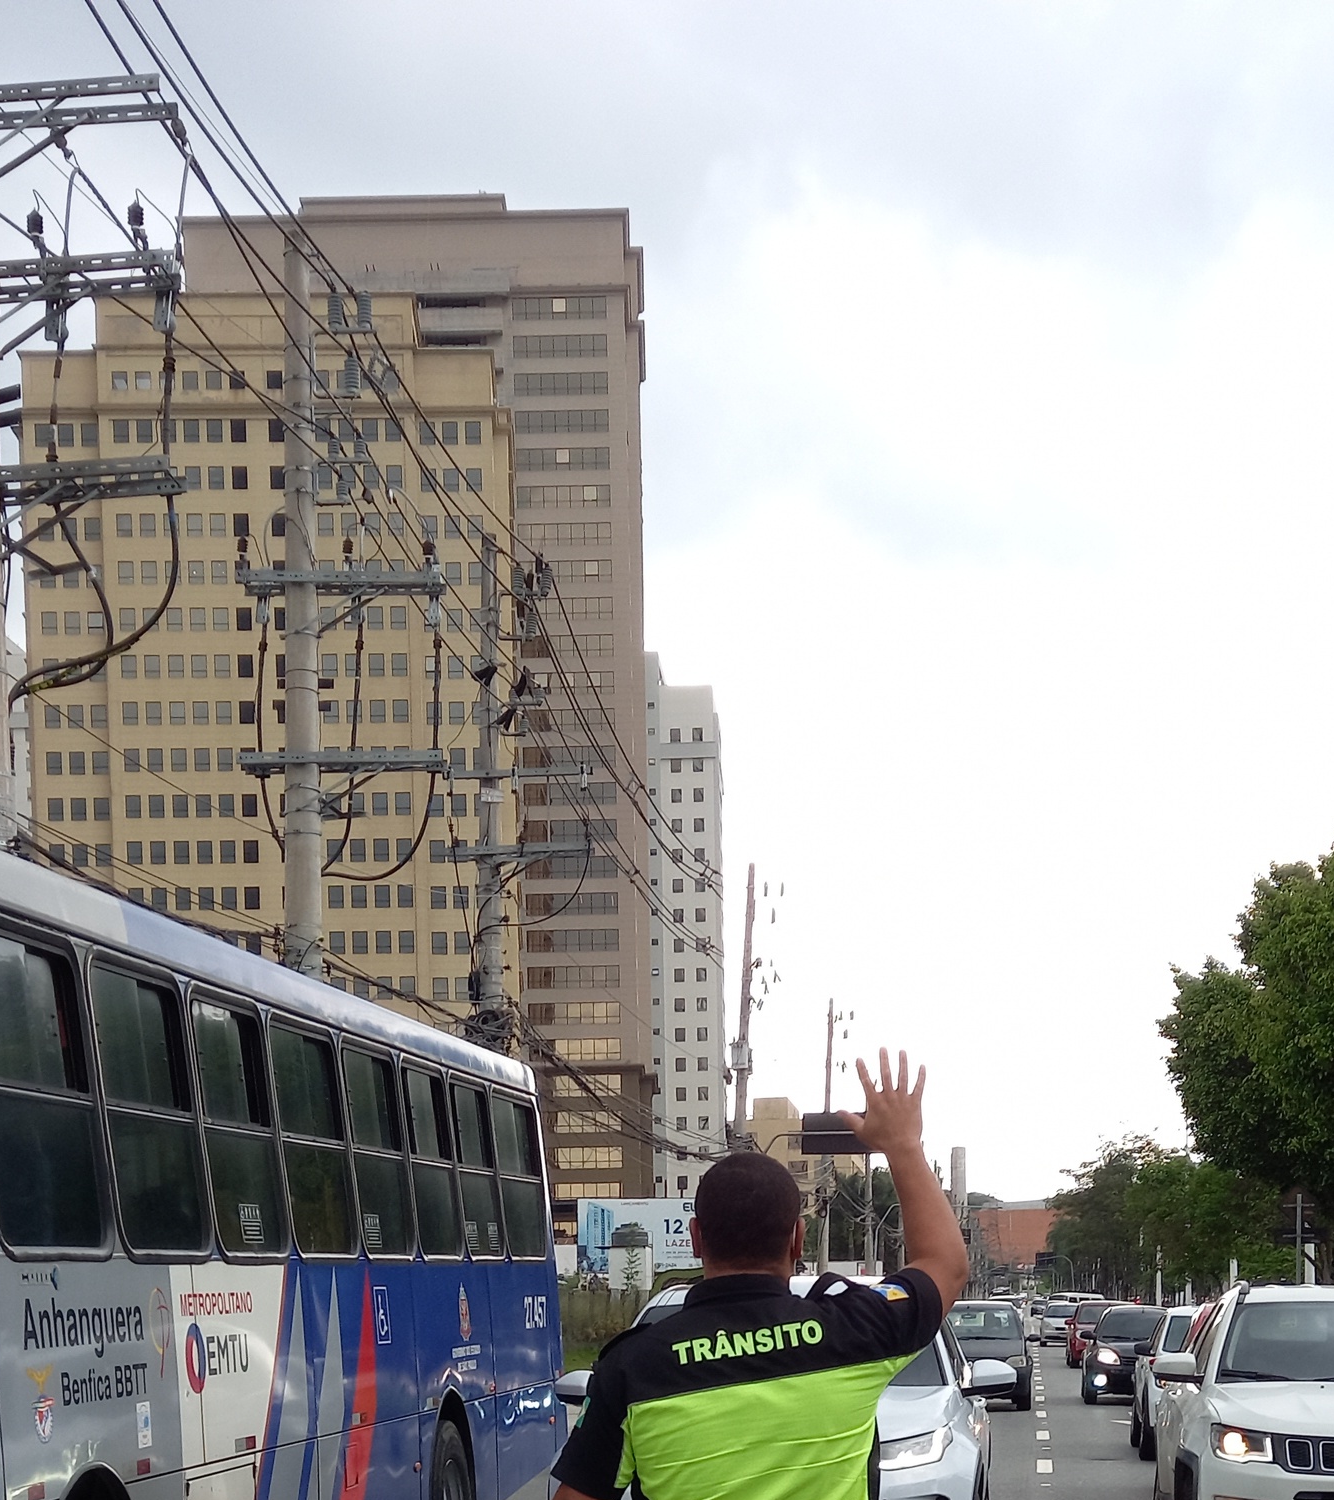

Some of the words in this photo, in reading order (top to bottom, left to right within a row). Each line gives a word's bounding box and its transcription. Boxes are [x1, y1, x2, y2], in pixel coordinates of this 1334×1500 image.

[180, 1291, 253, 1316] METROPOLITANO
[24, 1297, 144, 1358] Anhanguera
[671, 1319, 823, 1365] TRÂNSITO
[206, 1334, 249, 1376] EMTU
[61, 1368, 112, 1406] Benfica
[114, 1363, 147, 1398] BBTT
